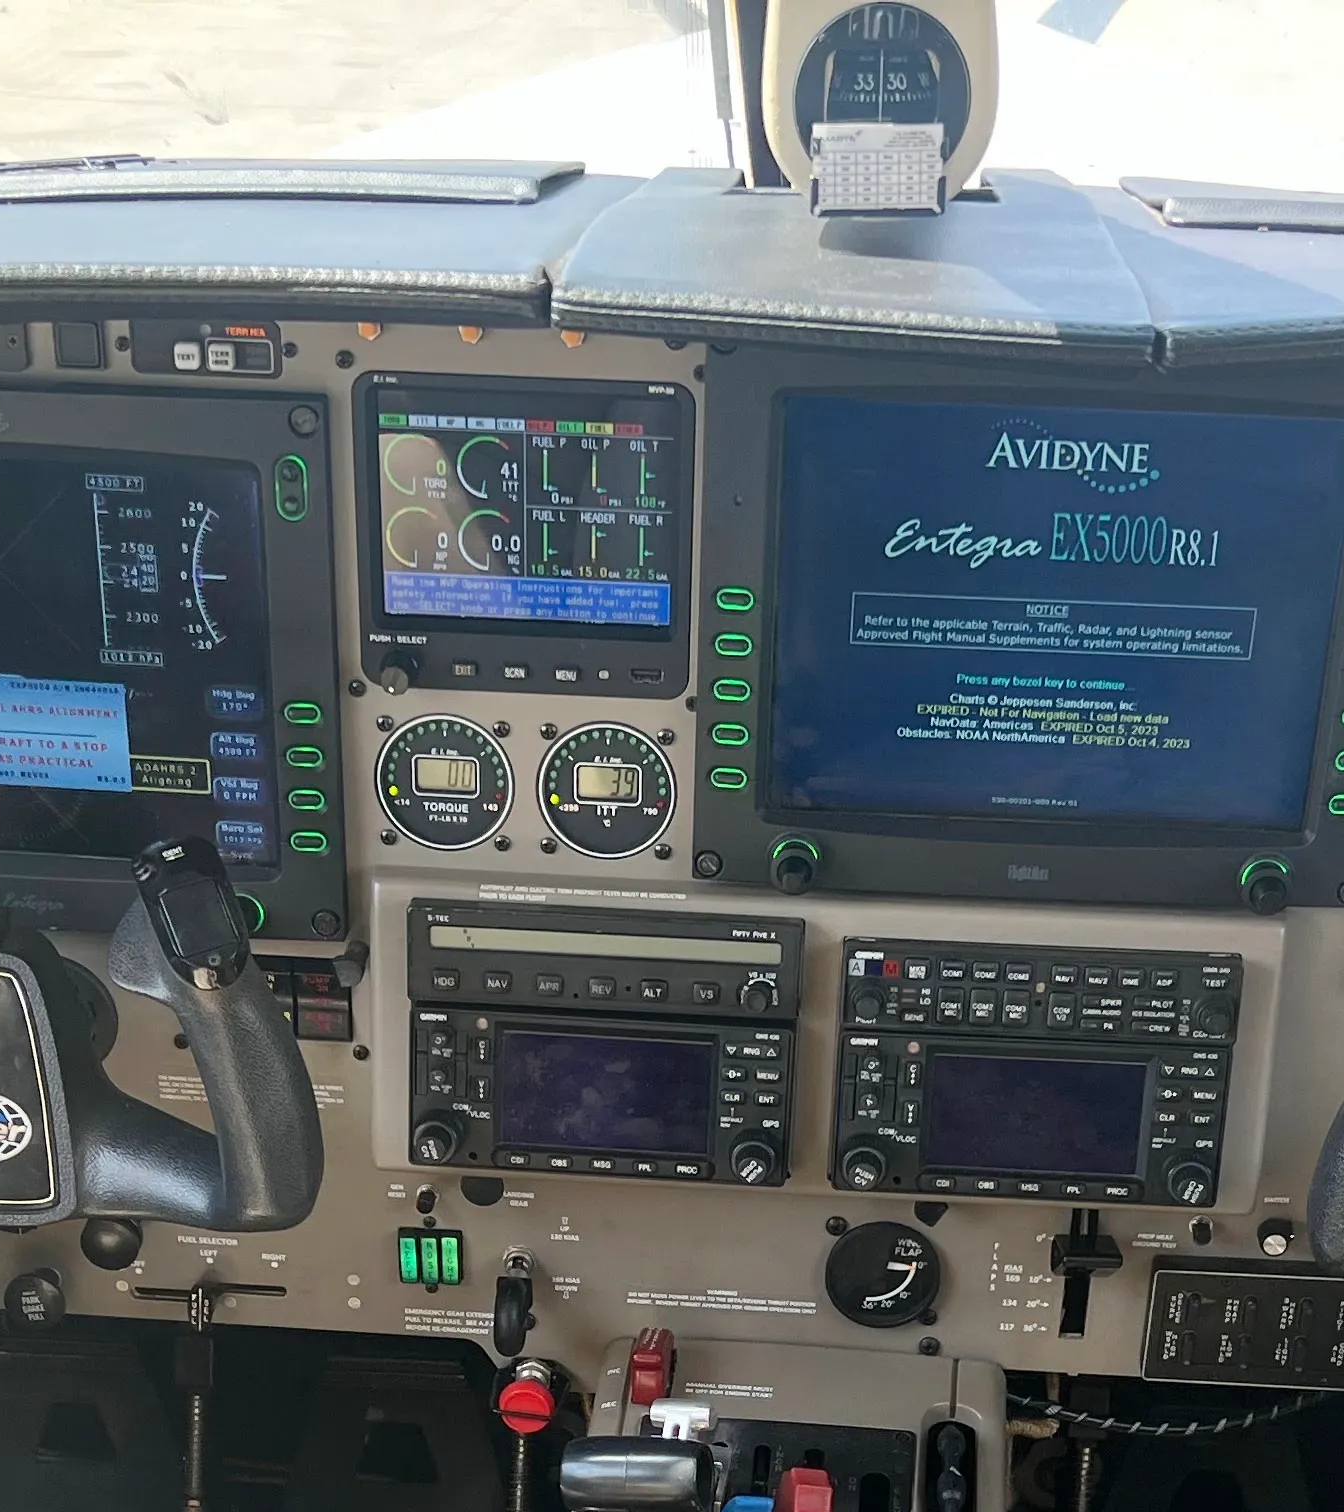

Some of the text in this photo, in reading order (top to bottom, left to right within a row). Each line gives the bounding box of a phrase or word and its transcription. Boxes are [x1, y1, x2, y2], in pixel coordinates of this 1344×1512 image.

[854, 73, 906, 90] 33 30
[533, 437, 566, 448] FUEL P
[581, 439, 610, 450] OIL P
[630, 440, 647, 452] OIL
[985, 432, 1150, 473] AVIDYNE
[436, 459, 446, 476] 0
[500, 462, 518, 479] 41
[533, 511, 566, 522] FUEL L
[581, 512, 615, 524] HEADER
[629, 515, 662, 526] FUEL R
[438, 532, 448, 549] 0
[492, 535, 520, 552] 0.0
[885, 512, 1219, 568] Entegra EX5000 R8.1
[508, 555, 520, 565] NG
[1026, 604, 1069, 617] NOTICE
[864, 616, 1232, 640] Refer to the applicable Terrain, Traffic, Radar, and Lightning sensor
[370, 634, 427, 645] PUSH SELECT
[857, 630, 1243, 654] Approved Flight Manual Supplements for system operating limitations.
[455, 665, 472, 675] EXIT
[505, 667, 525, 678] SCRN
[556, 669, 576, 681] MENU
[956, 674, 988, 685] Press
[991, 676, 1009, 687] any
[1044, 678, 1063, 690] key
[1066, 678, 1077, 688] to
[917, 704, 969, 716] EXPIRED
[980, 707, 998, 717] Not
[1001, 708, 1019, 718] For
[1022, 708, 1079, 722] Navigation
[1090, 712, 1117, 722] Load
[1145, 714, 1169, 724] data
[982, 718, 1033, 731] Americas
[1041, 721, 1093, 733] EXPIRED
[1096, 723, 1114, 733] Oct
[1132, 725, 1158, 735] 2023
[40, 739, 54, 749] TO
[61, 741, 68, 750] A
[74, 741, 108, 751] STOP
[956, 730, 989, 740] NOAA
[992, 731, 1065, 743] NorthAmerica
[1072, 734, 1124, 746] EXPIRED
[1128, 737, 1146, 747] Oct
[1162, 738, 1190, 749] 2023
[20, 756, 93, 768] PRACTICAL
[135, 763, 185, 775] ADAHRS
[142, 775, 192, 787] Aligning
[610, 770, 635, 797] 39
[423, 802, 469, 814] TORQUE
[596, 805, 618, 817] ITT
[942, 970, 963, 978] COM1
[974, 971, 995, 979] COM2
[1056, 975, 1074, 983] NAV1
[434, 976, 455, 986] HDG
[487, 979, 508, 989] NAV
[539, 980, 559, 991] APR
[1206, 979, 1225, 987] TEST
[592, 984, 612, 995] REV
[643, 987, 662, 998] ALT
[699, 989, 714, 999] VS
[1149, 1024, 1170, 1032] CREW
[744, 1047, 760, 1056] RNG
[756, 1072, 779, 1081] MENU
[1181, 1067, 1198, 1075] RNG
[724, 1093, 740, 1102] CLR
[758, 1095, 774, 1104] ENT
[1193, 1091, 1216, 1100] MENU
[1159, 1113, 1175, 1122] CLR
[1194, 1115, 1210, 1124] ENT
[762, 1120, 780, 1128] GPS
[593, 1160, 611, 1169] MSG
[638, 1163, 651, 1172] FPL
[677, 1165, 697, 1175] PROC
[936, 1179, 950, 1188] CDI
[1107, 1187, 1128, 1196] PROC
[178, 1236, 238, 1248] FUEL SELECTOR
[199, 1249, 218, 1258] LEFT
[894, 1247, 923, 1257] FLAP
[262, 1253, 286, 1263] RIGHT
[1005, 1264, 1023, 1273] KIAS
[1002, 1299, 1017, 1307] 134
[999, 1323, 1015, 1331] 117
